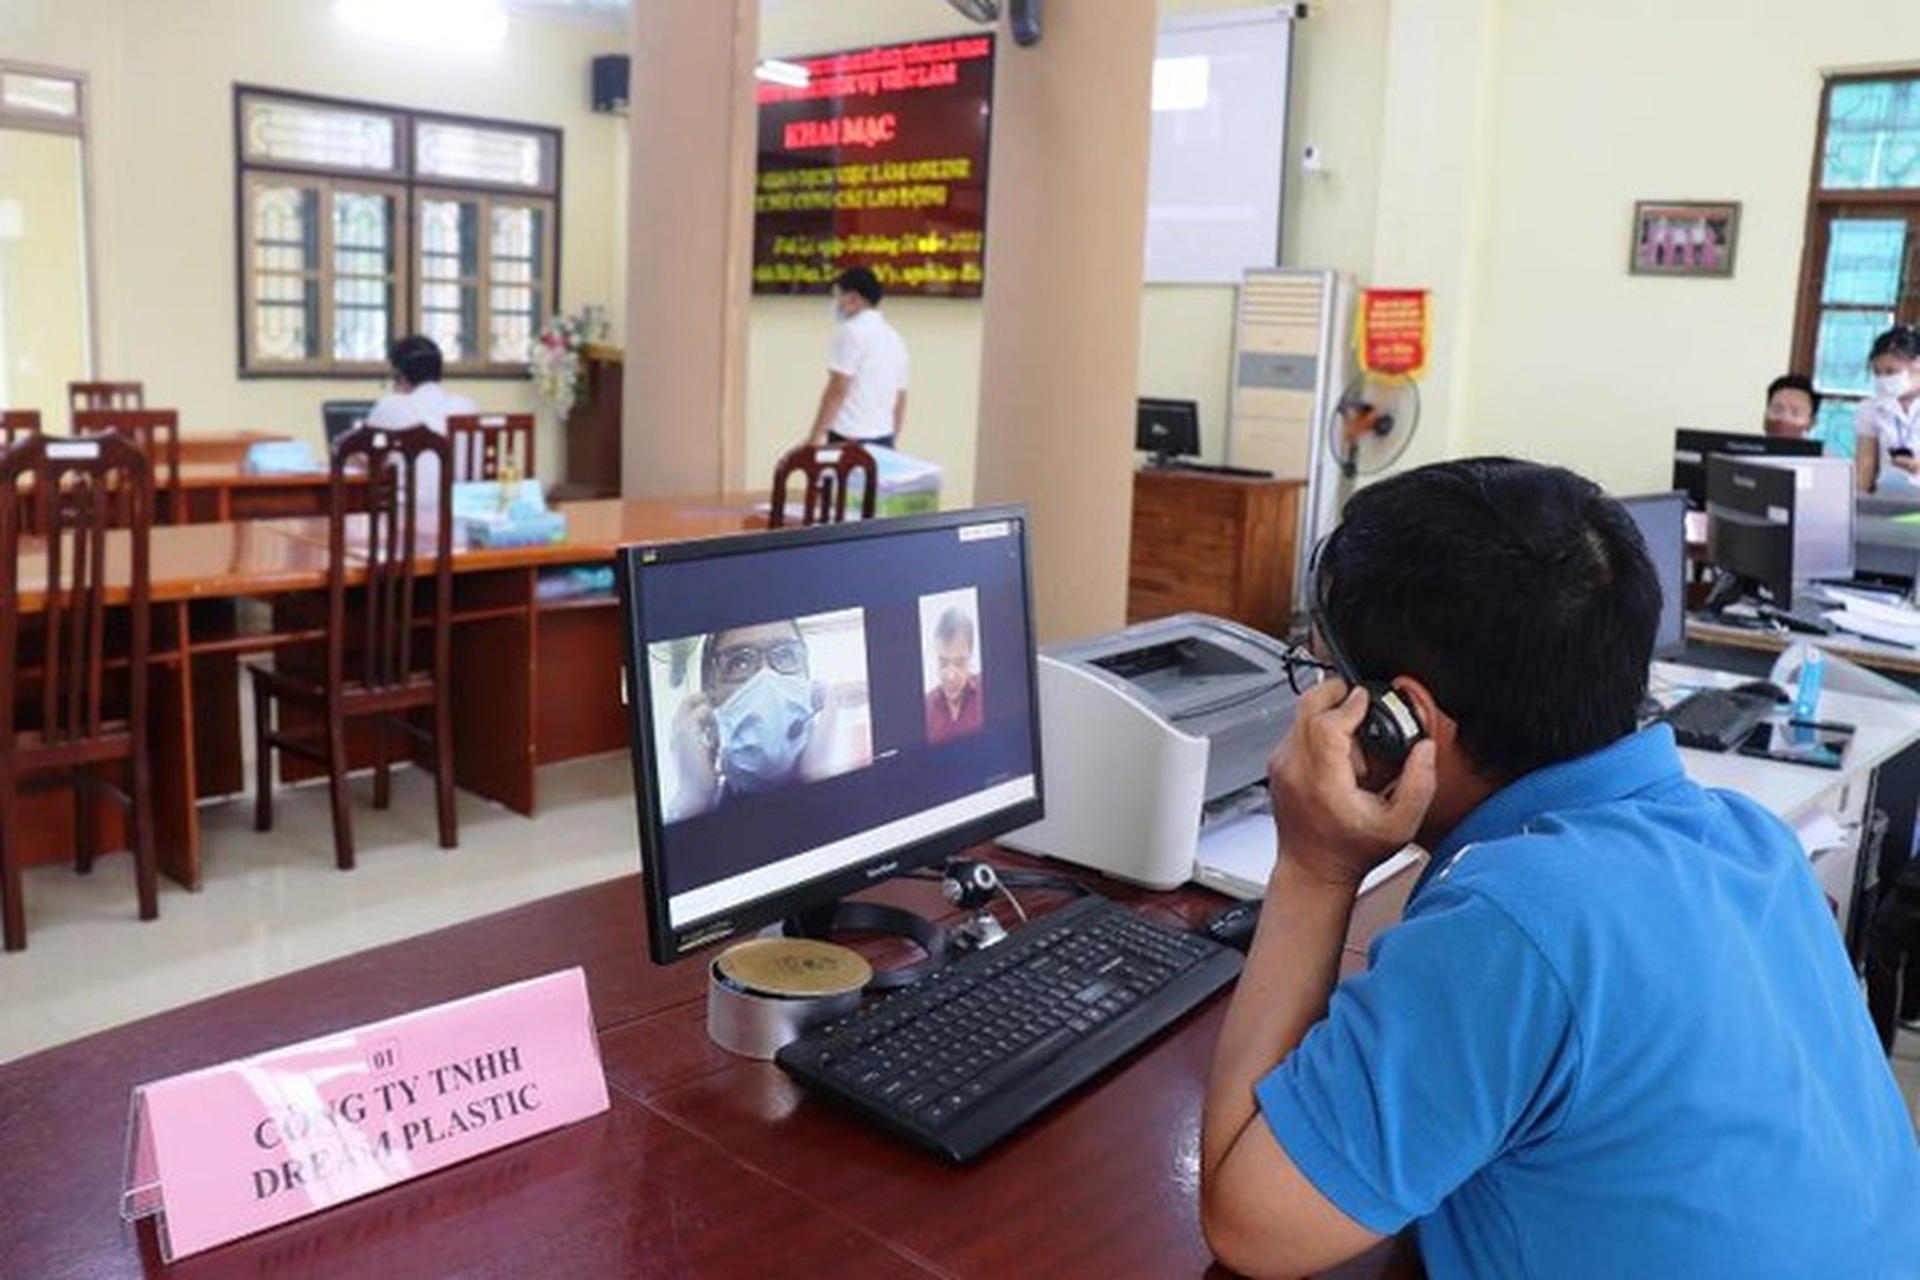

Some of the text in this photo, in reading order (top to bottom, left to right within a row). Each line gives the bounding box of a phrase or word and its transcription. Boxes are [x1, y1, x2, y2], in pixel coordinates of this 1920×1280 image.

[784, 114, 896, 149] KHAI MẠC
[373, 1048, 395, 1070] 01
[373, 1074, 420, 1113] TY
[427, 1046, 523, 1096] TNHH
[401, 1082, 542, 1151] PLASTIC
